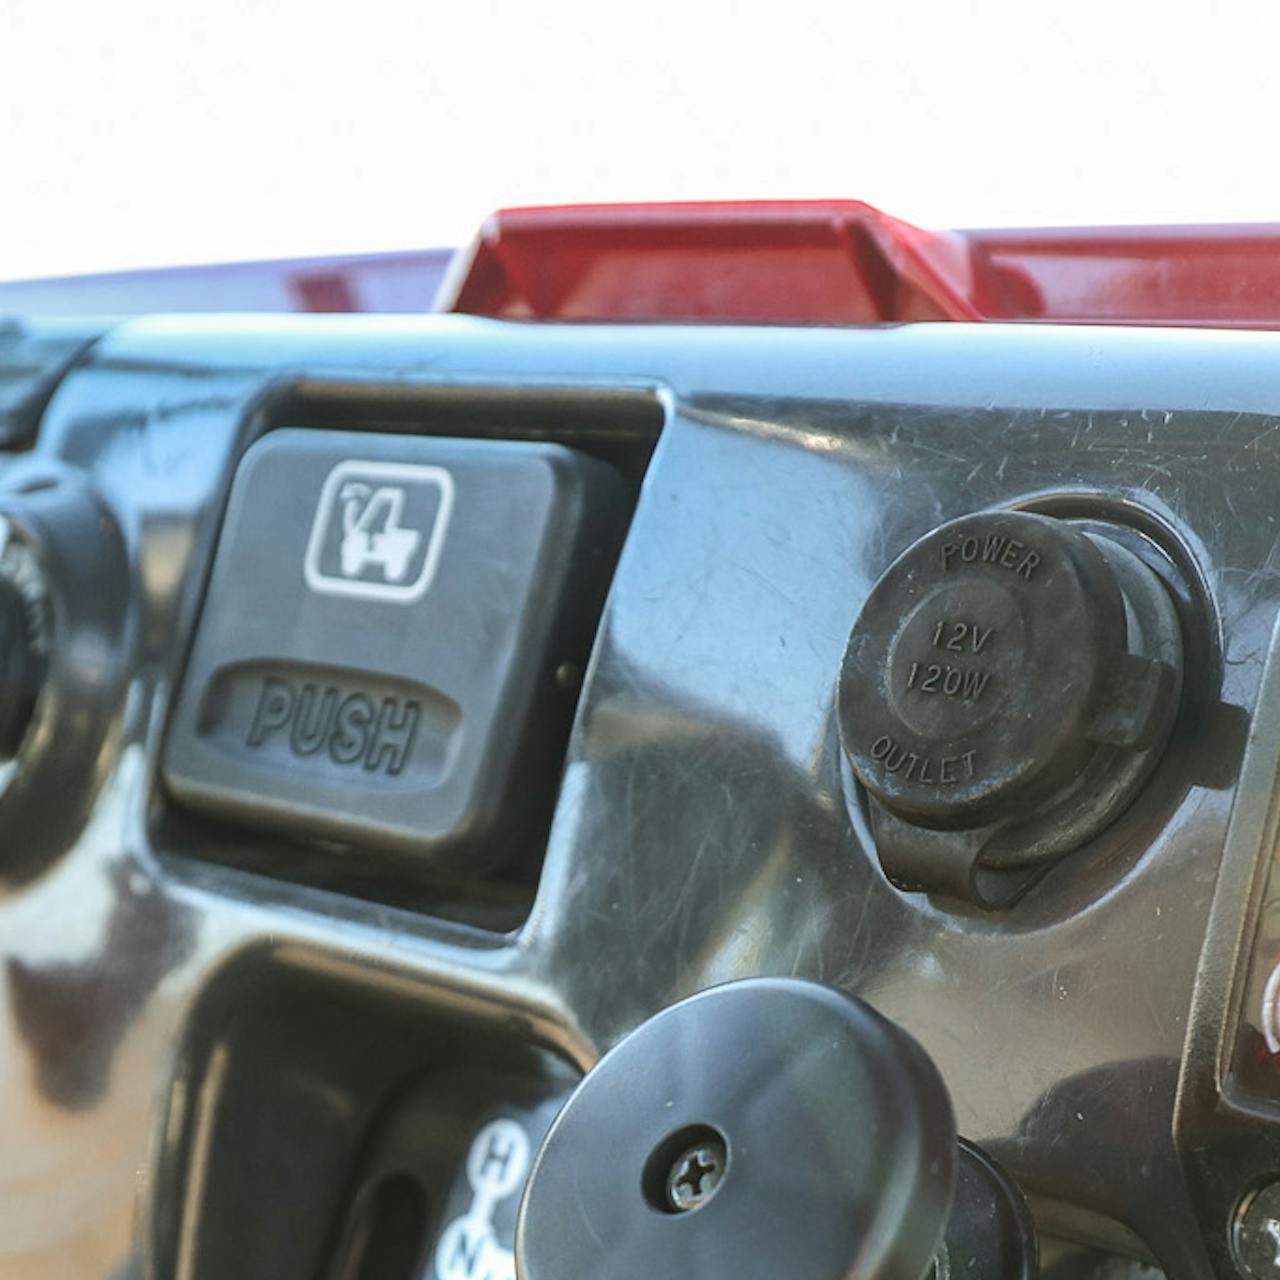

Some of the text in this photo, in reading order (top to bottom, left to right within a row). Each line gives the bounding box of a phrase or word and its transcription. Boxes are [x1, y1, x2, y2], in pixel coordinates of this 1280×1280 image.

[939, 534, 1042, 582] POWER
[929, 618, 997, 656] 12V
[905, 660, 991, 701] 120W
[246, 676, 420, 778] PUSH
[867, 733, 981, 787] OUTLET
[480, 1131, 516, 1184] H
[449, 1231, 489, 1276] N
